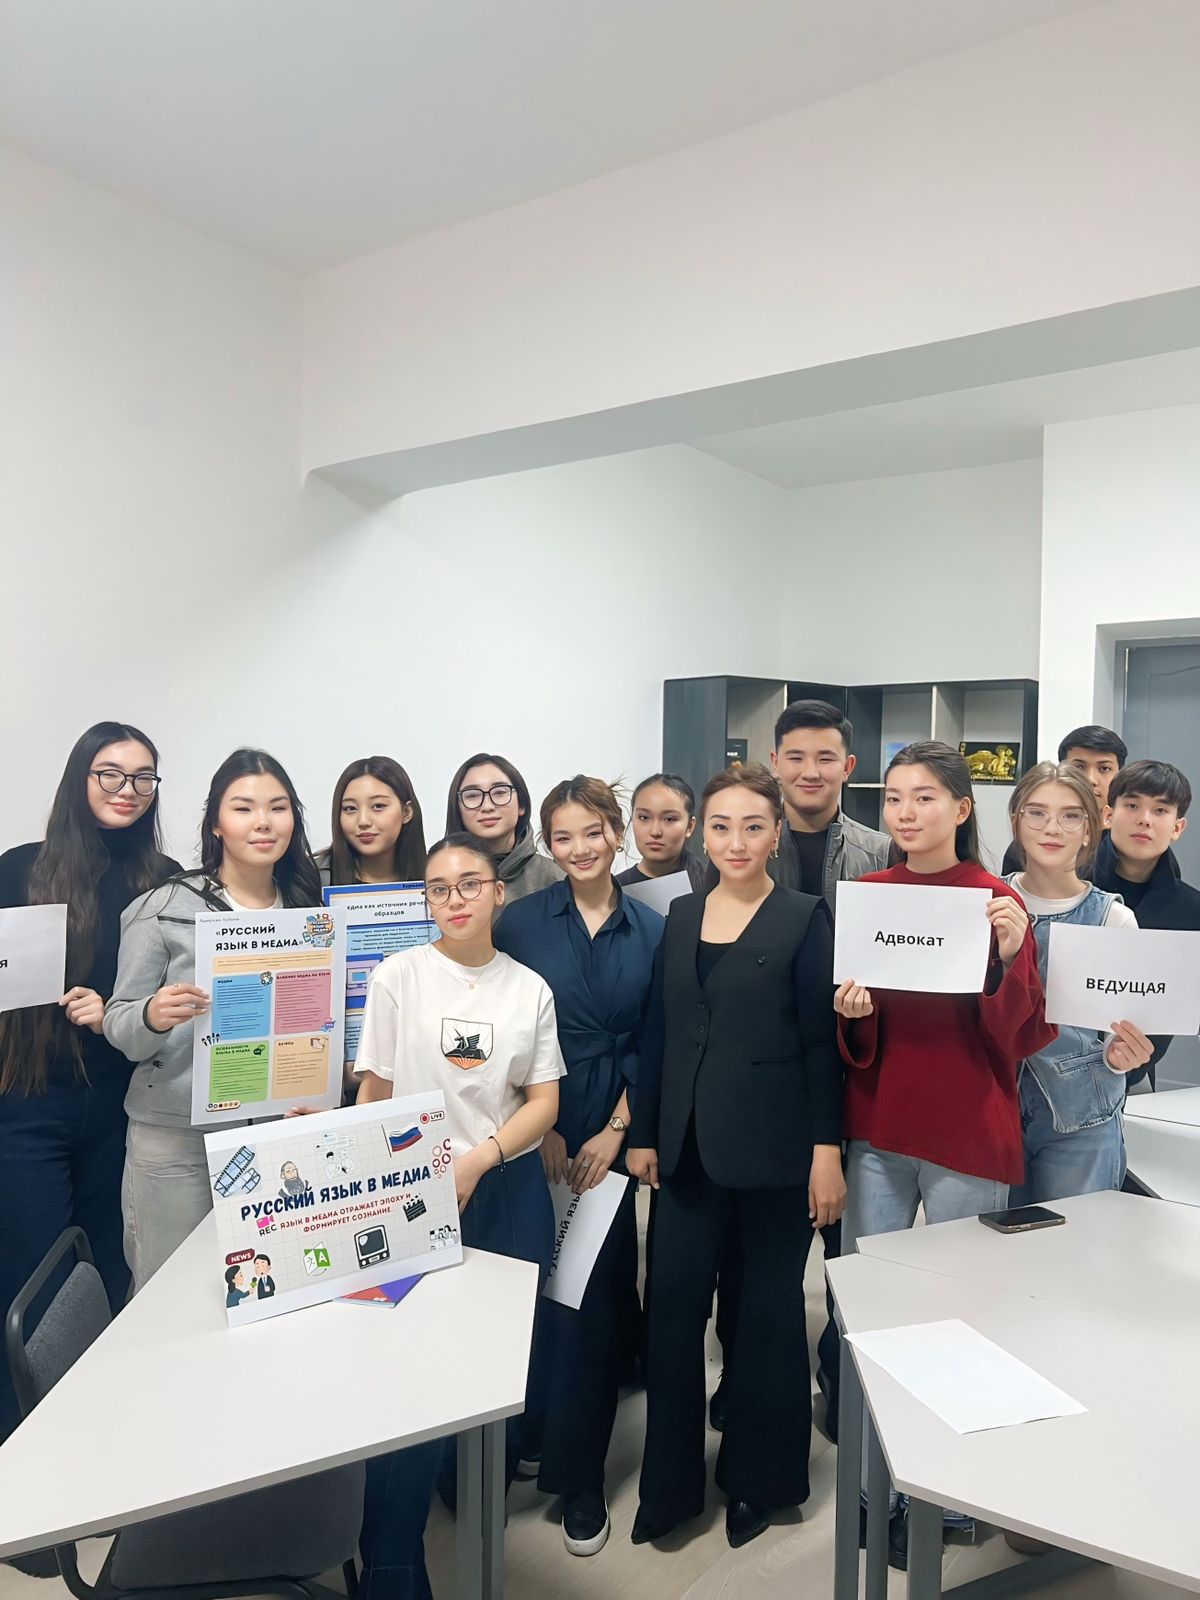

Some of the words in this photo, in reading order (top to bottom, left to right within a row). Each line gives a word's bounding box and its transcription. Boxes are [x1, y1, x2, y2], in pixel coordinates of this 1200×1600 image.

[215, 940, 248, 951] ЯЗЫК
[251, 940, 258, 949] В
[874, 930, 945, 947] Адвокат
[1086, 977, 1166, 996] ВЕДУЩАЯ
[241, 1186, 315, 1221] РУССКИЙ
[320, 1180, 363, 1203] ЯЗЫК
[367, 1177, 377, 1193] В
[381, 1165, 431, 1190] МЕДИА
[280, 1219, 303, 1230] ЯЗЫК
[312, 1210, 338, 1222] МЕДИА
[339, 1200, 379, 1215] ОТРАЖАЕТ
[380, 1194, 405, 1206] ЭПОХУ
[405, 1192, 411, 1200] И
[566, 1193, 581, 1218] ЯЗЫ
[258, 1224, 278, 1237] REC
[303, 1216, 350, 1233] ФОРМИРУЕТ
[231, 1252, 252, 1263] NEWS
